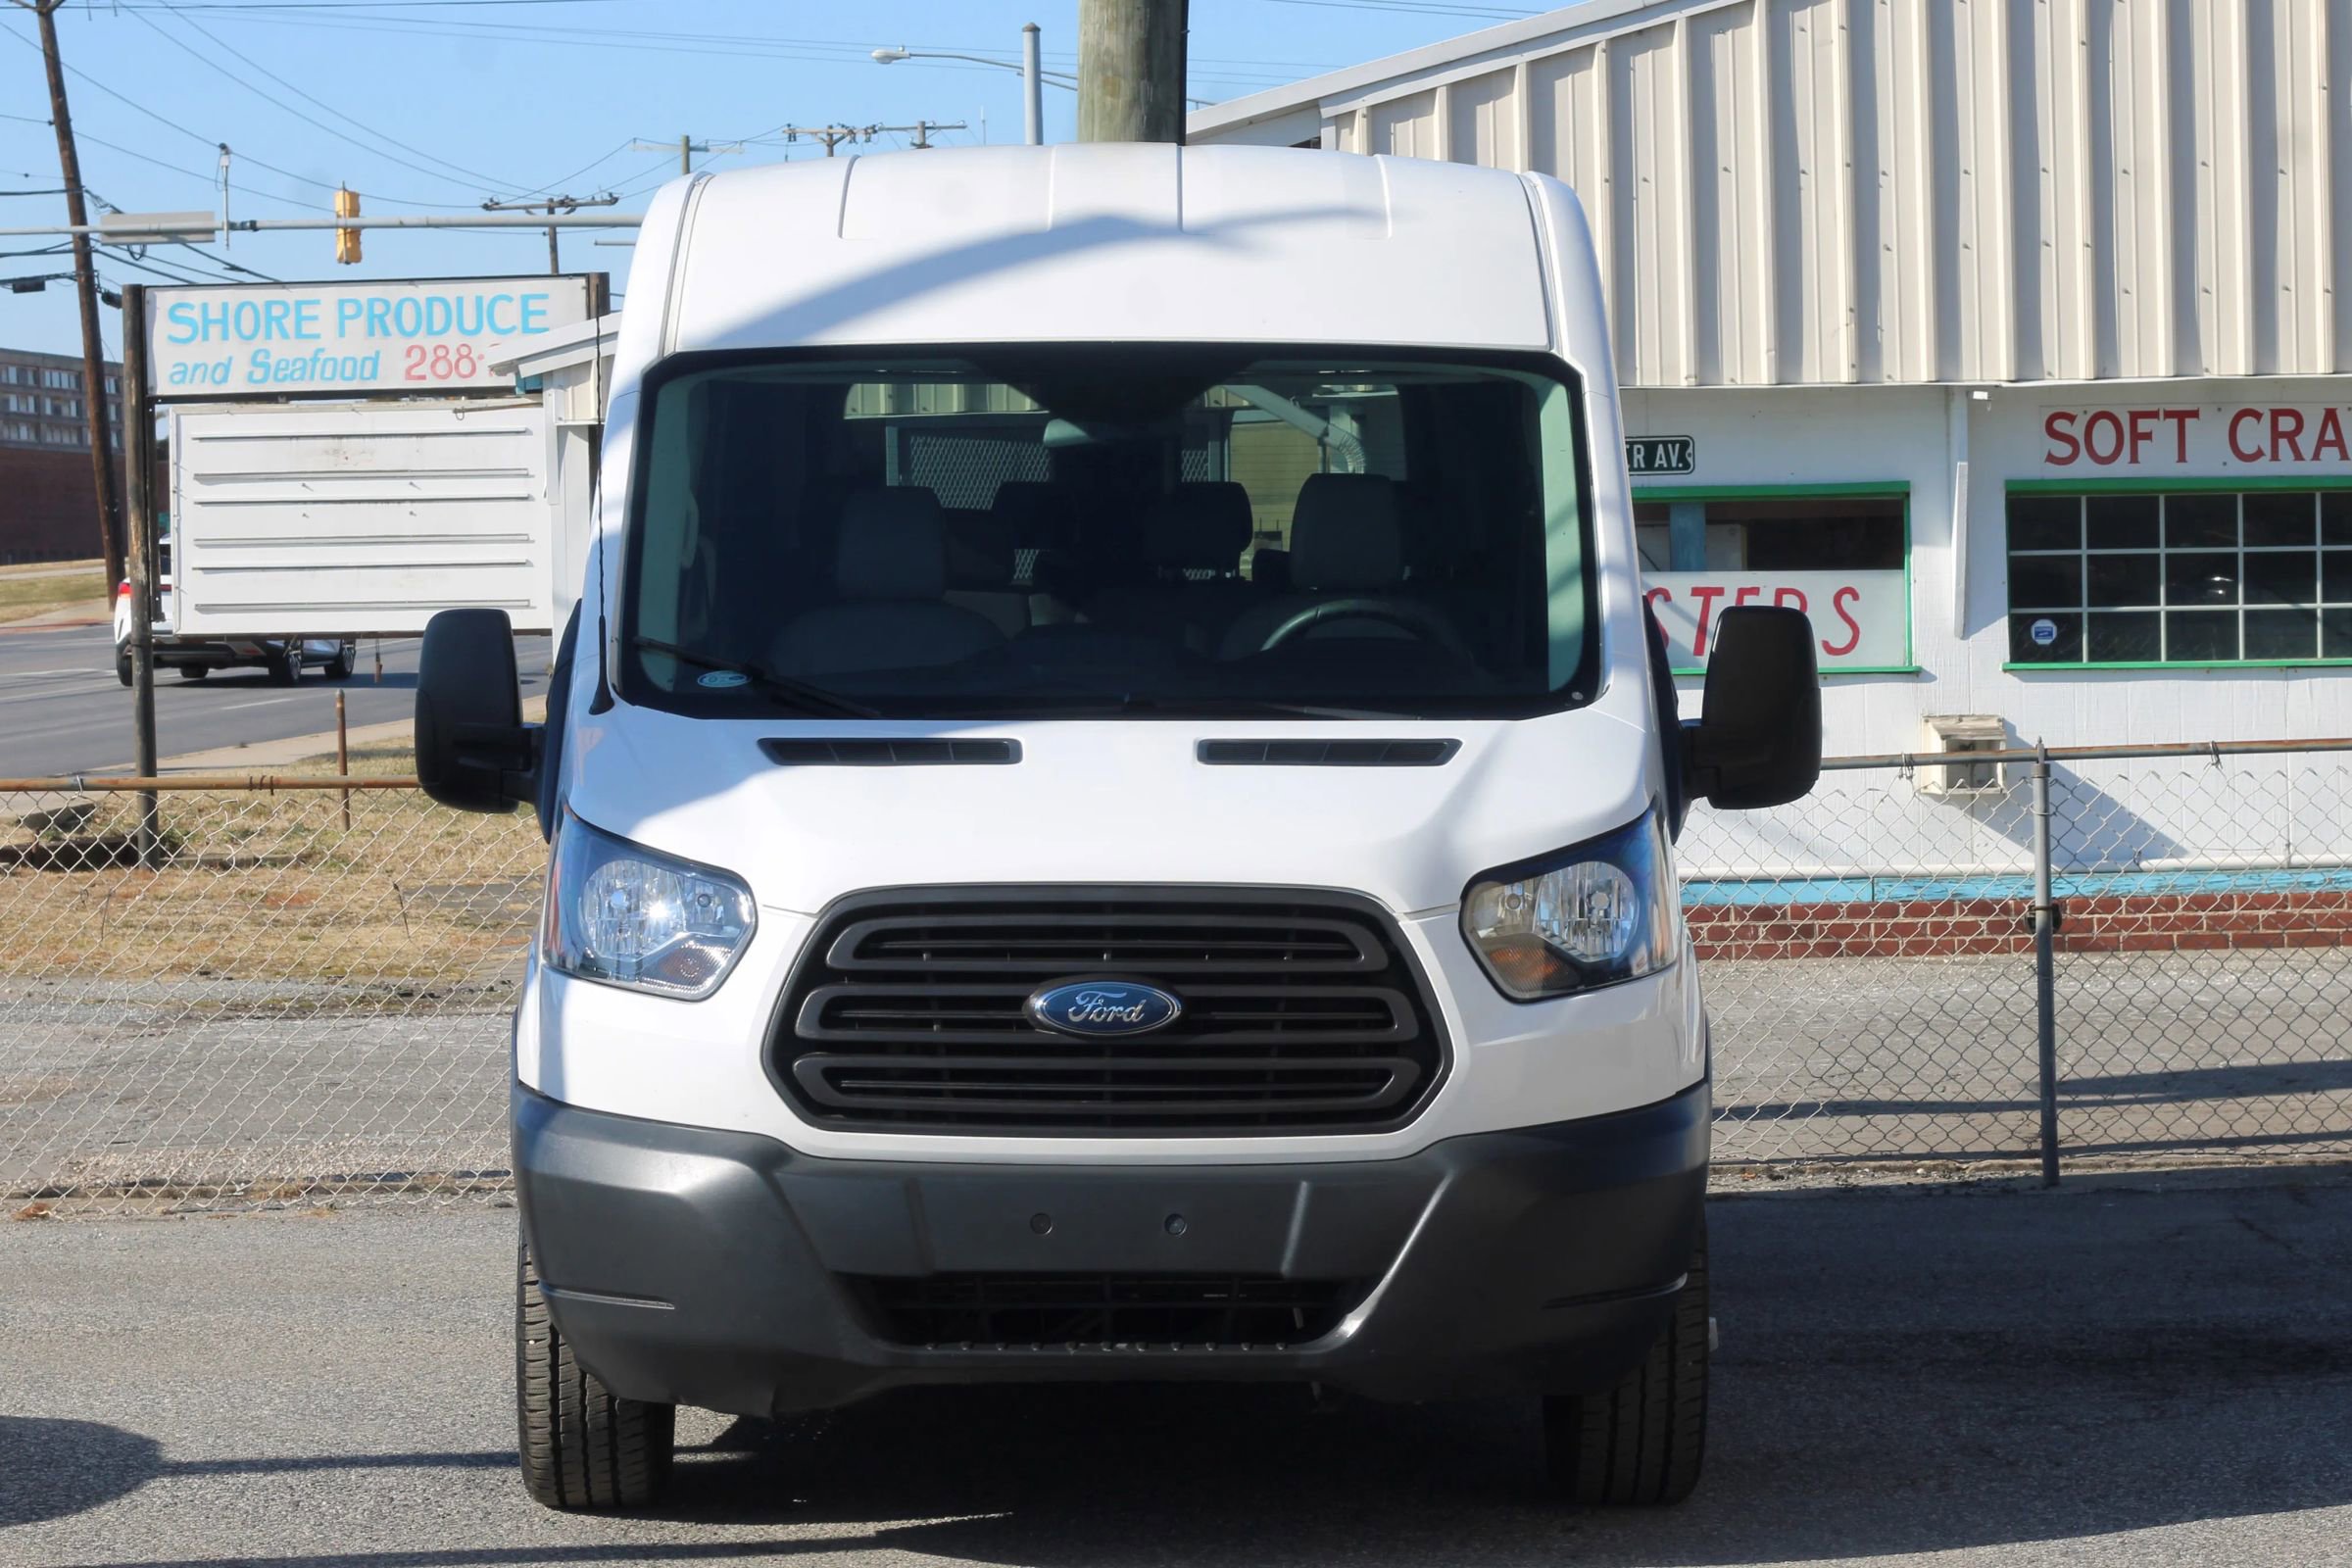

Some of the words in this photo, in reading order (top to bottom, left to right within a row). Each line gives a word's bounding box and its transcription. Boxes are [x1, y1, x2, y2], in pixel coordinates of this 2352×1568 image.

[167, 298, 321, 344] SHORE
[337, 293, 550, 338] PRODUCE
[168, 356, 233, 385] and
[247, 347, 381, 384] Seafood
[1626, 444, 1645, 468] R
[1653, 443, 1684, 467] AV.
[2044, 407, 2200, 466] SOFT
[2228, 407, 2352, 463] CRA
[1068, 991, 1146, 1022] Ford
